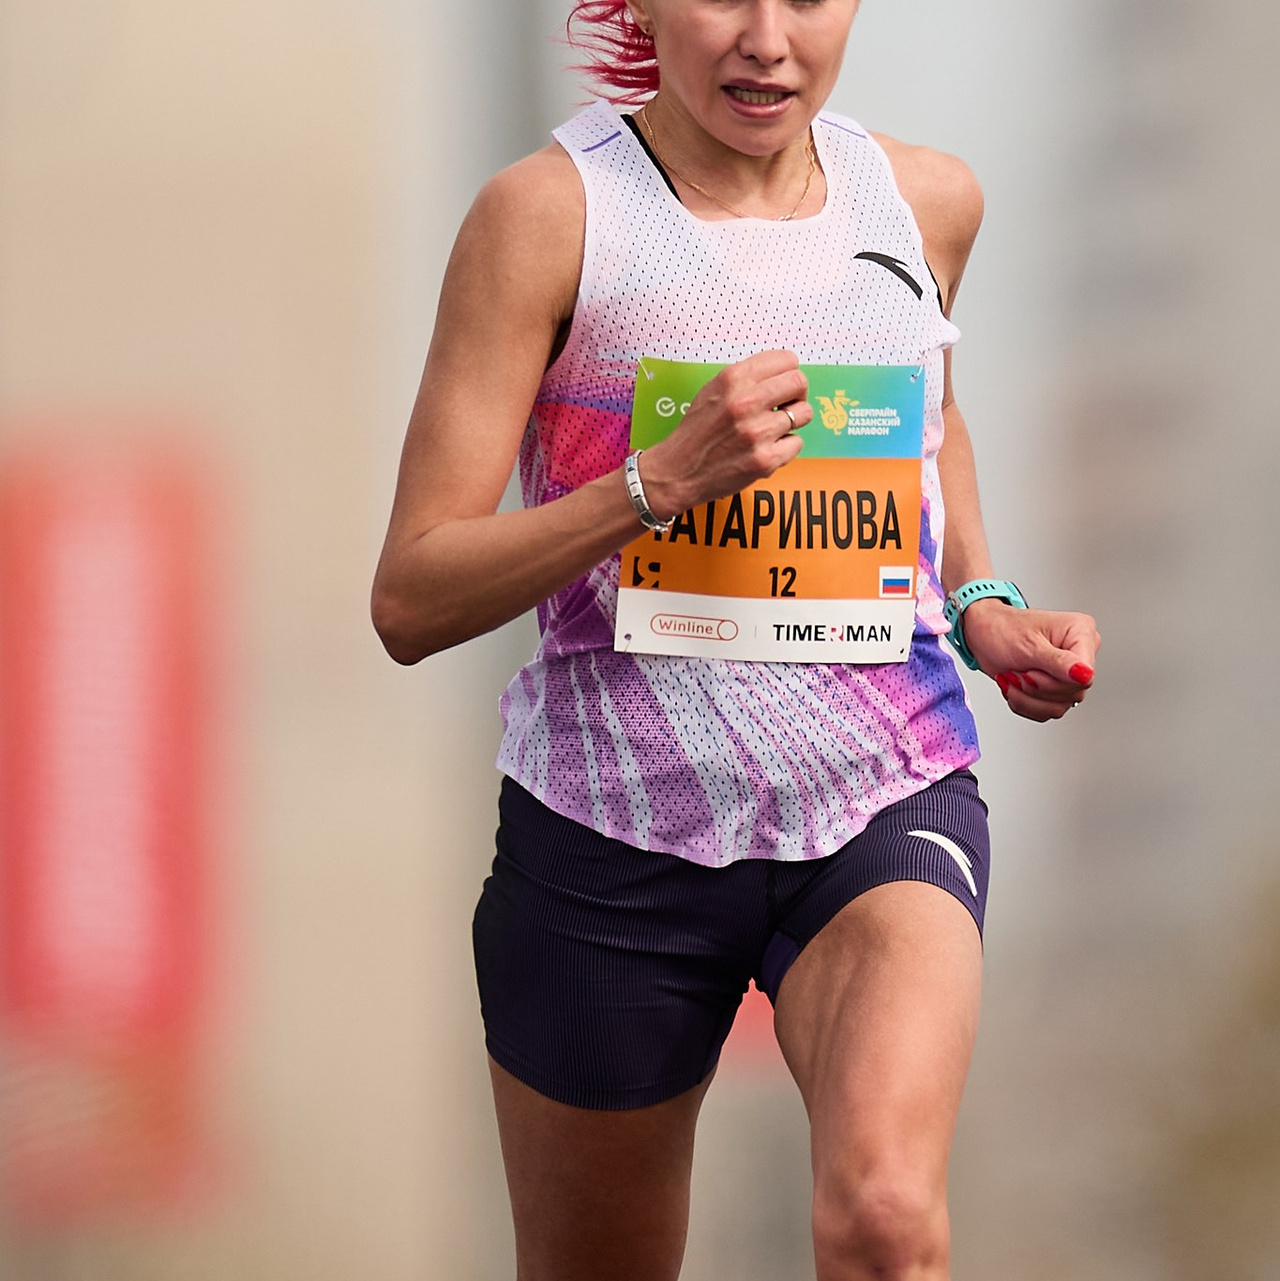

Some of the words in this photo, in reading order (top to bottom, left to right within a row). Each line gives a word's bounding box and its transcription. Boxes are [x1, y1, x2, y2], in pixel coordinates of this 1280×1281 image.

[848, 416, 901, 427] КАЗАНСКИЙ
[847, 426, 890, 436] МАРАФОН
[653, 490, 902, 550] АТАРИНОВА
[769, 566, 797, 598] 12
[658, 618, 714, 636] Winline
